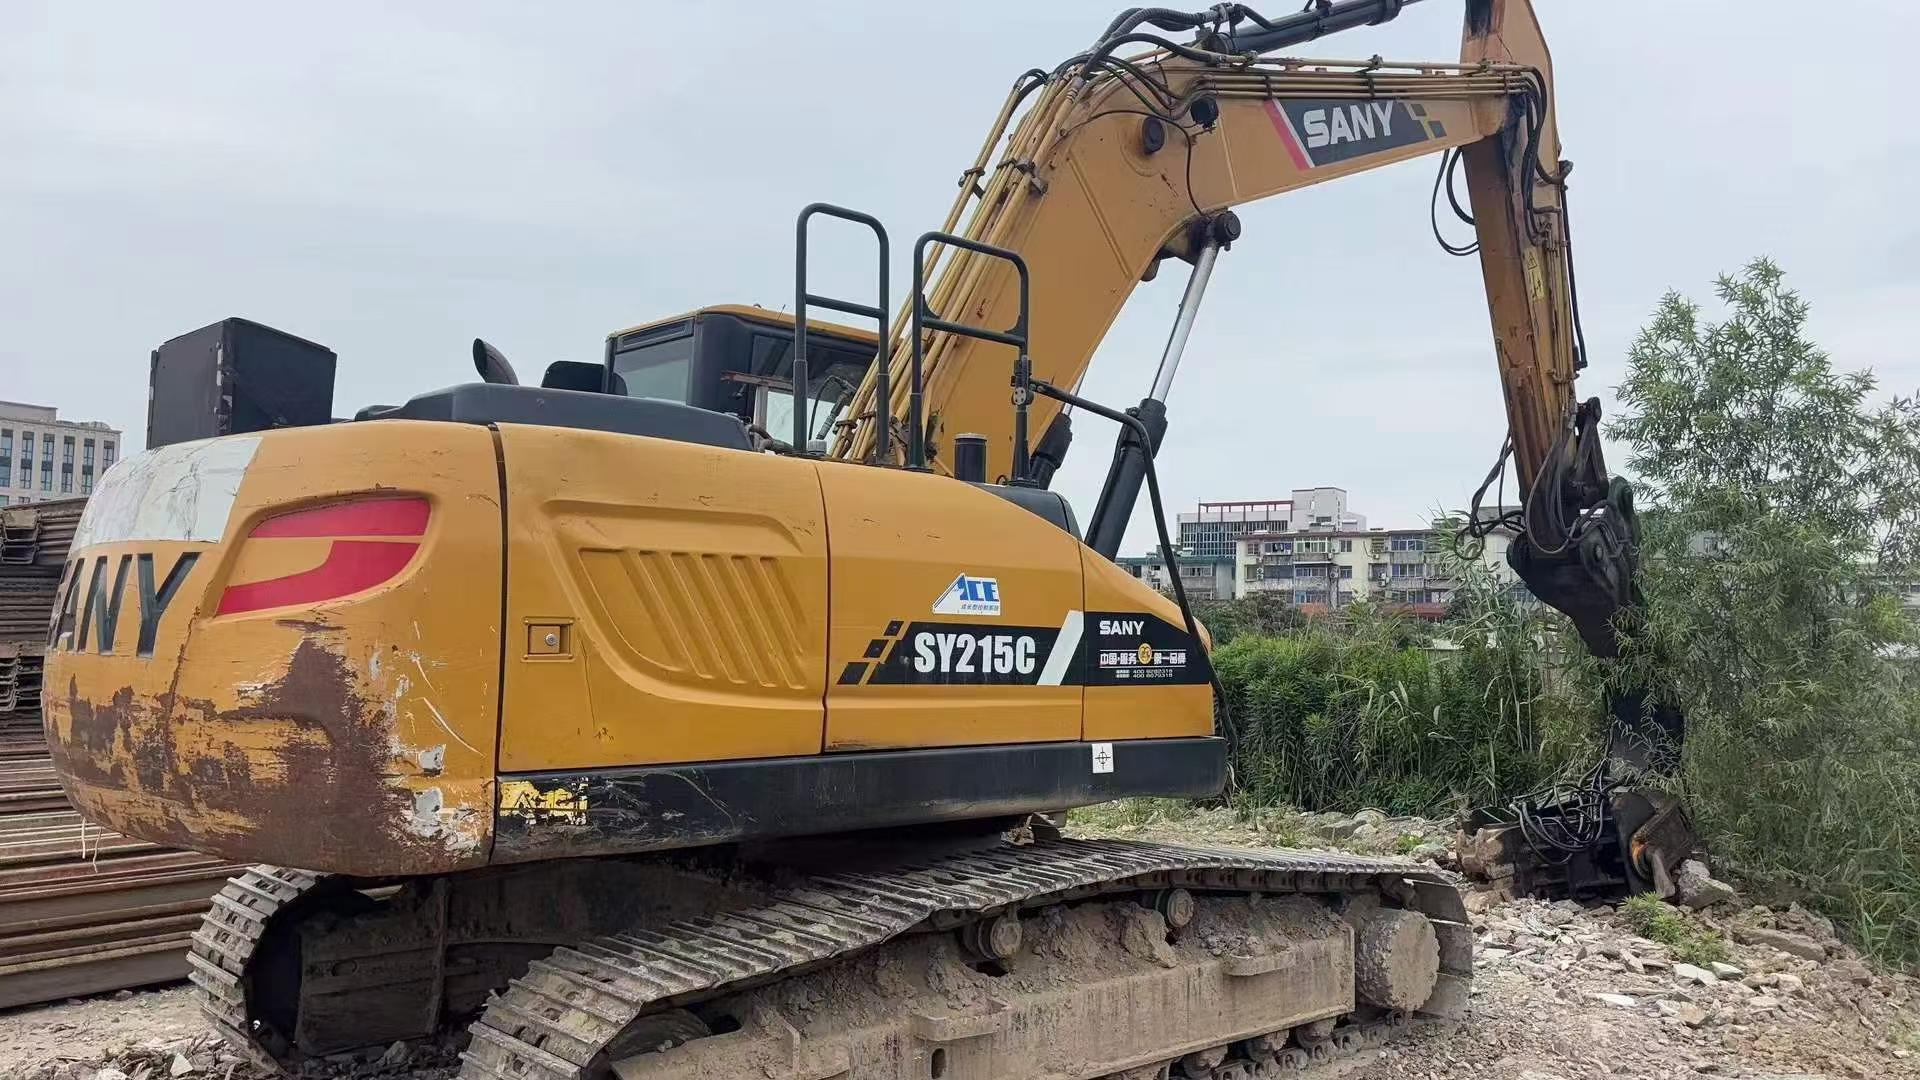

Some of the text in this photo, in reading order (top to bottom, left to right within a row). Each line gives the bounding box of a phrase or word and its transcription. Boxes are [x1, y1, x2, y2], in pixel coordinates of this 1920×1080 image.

[1303, 100, 1395, 149] SANY
[47, 552, 202, 657] ANY
[1099, 620, 1145, 636] SANY
[914, 631, 1036, 674] SY215C
